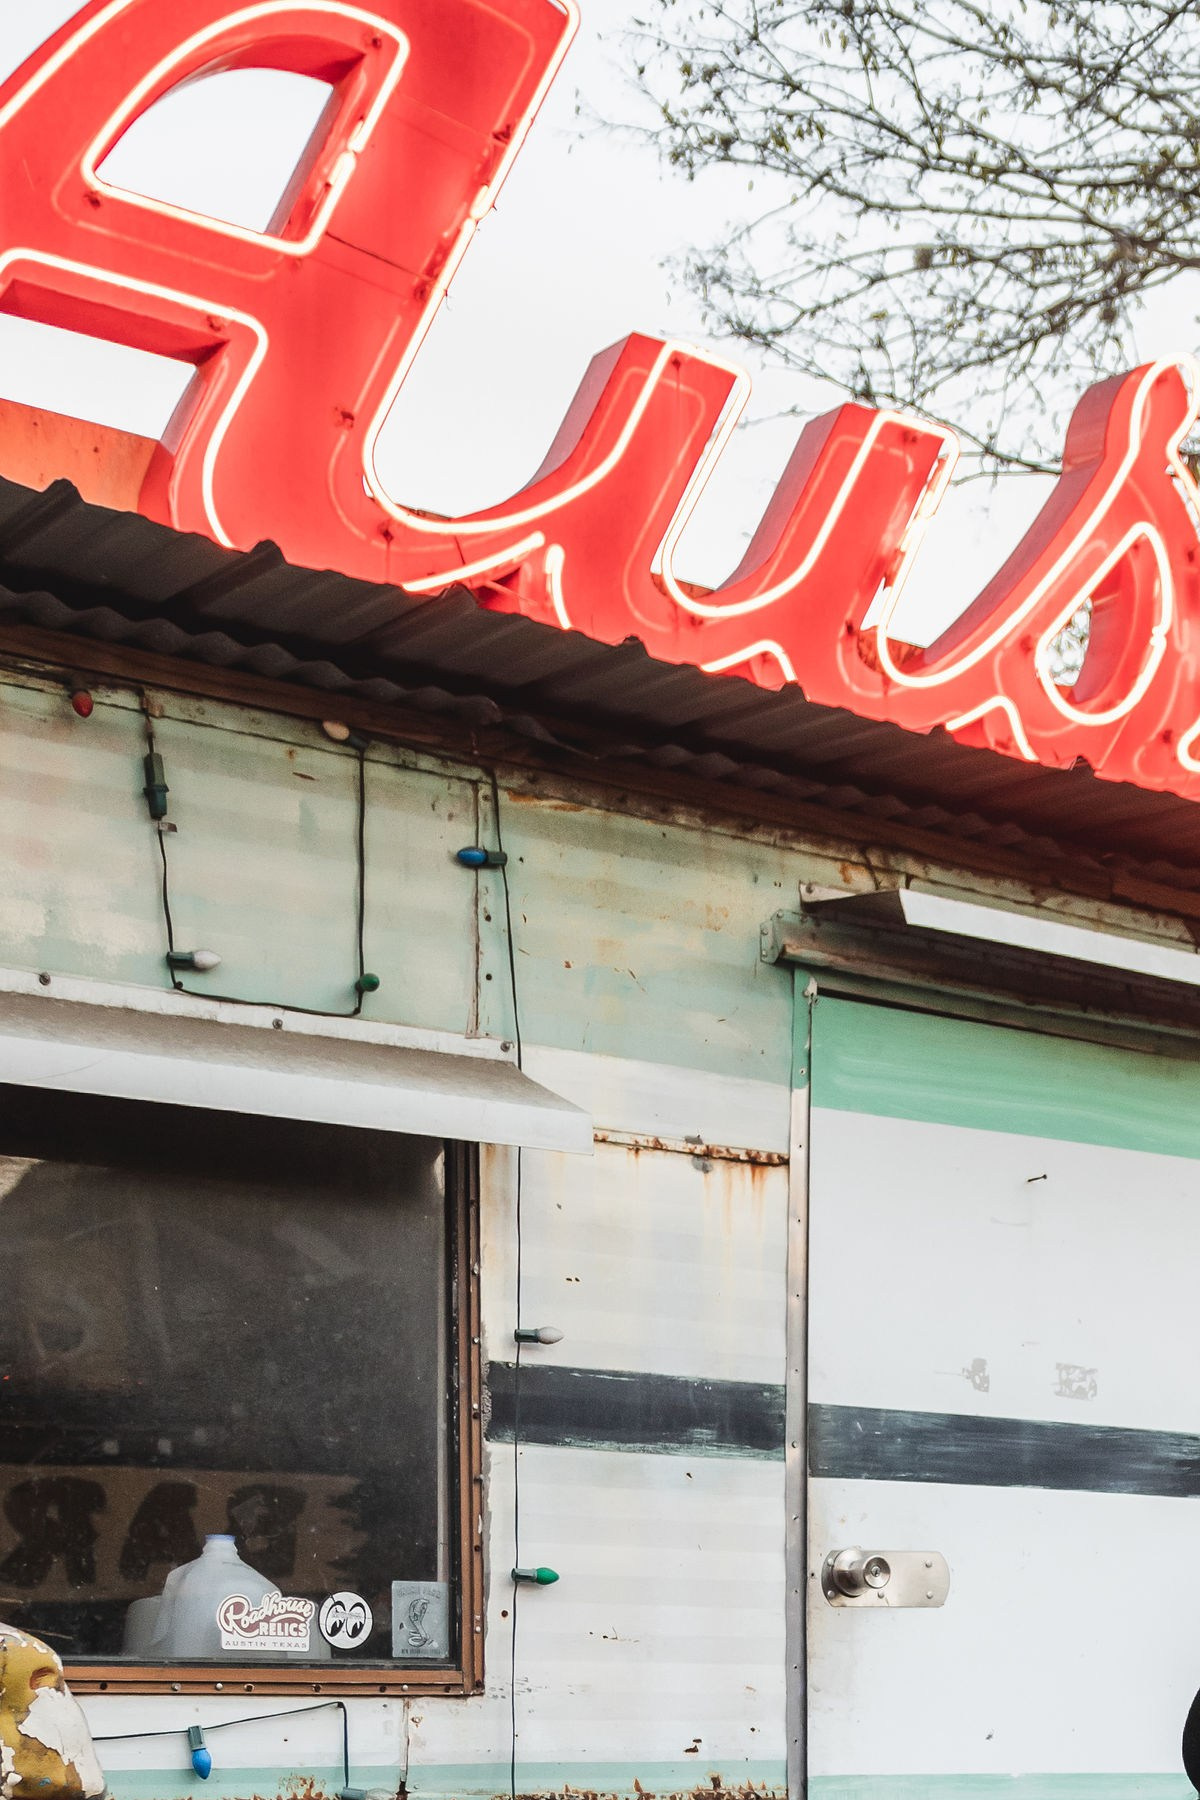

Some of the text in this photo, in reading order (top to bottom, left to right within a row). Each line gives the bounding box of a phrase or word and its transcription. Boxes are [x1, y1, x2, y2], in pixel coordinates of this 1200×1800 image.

[218, 1592, 315, 1638] Roadhouse
[258, 1621, 308, 1637] RELICS
[225, 1640, 307, 1649] AUSTIN TEXAS
